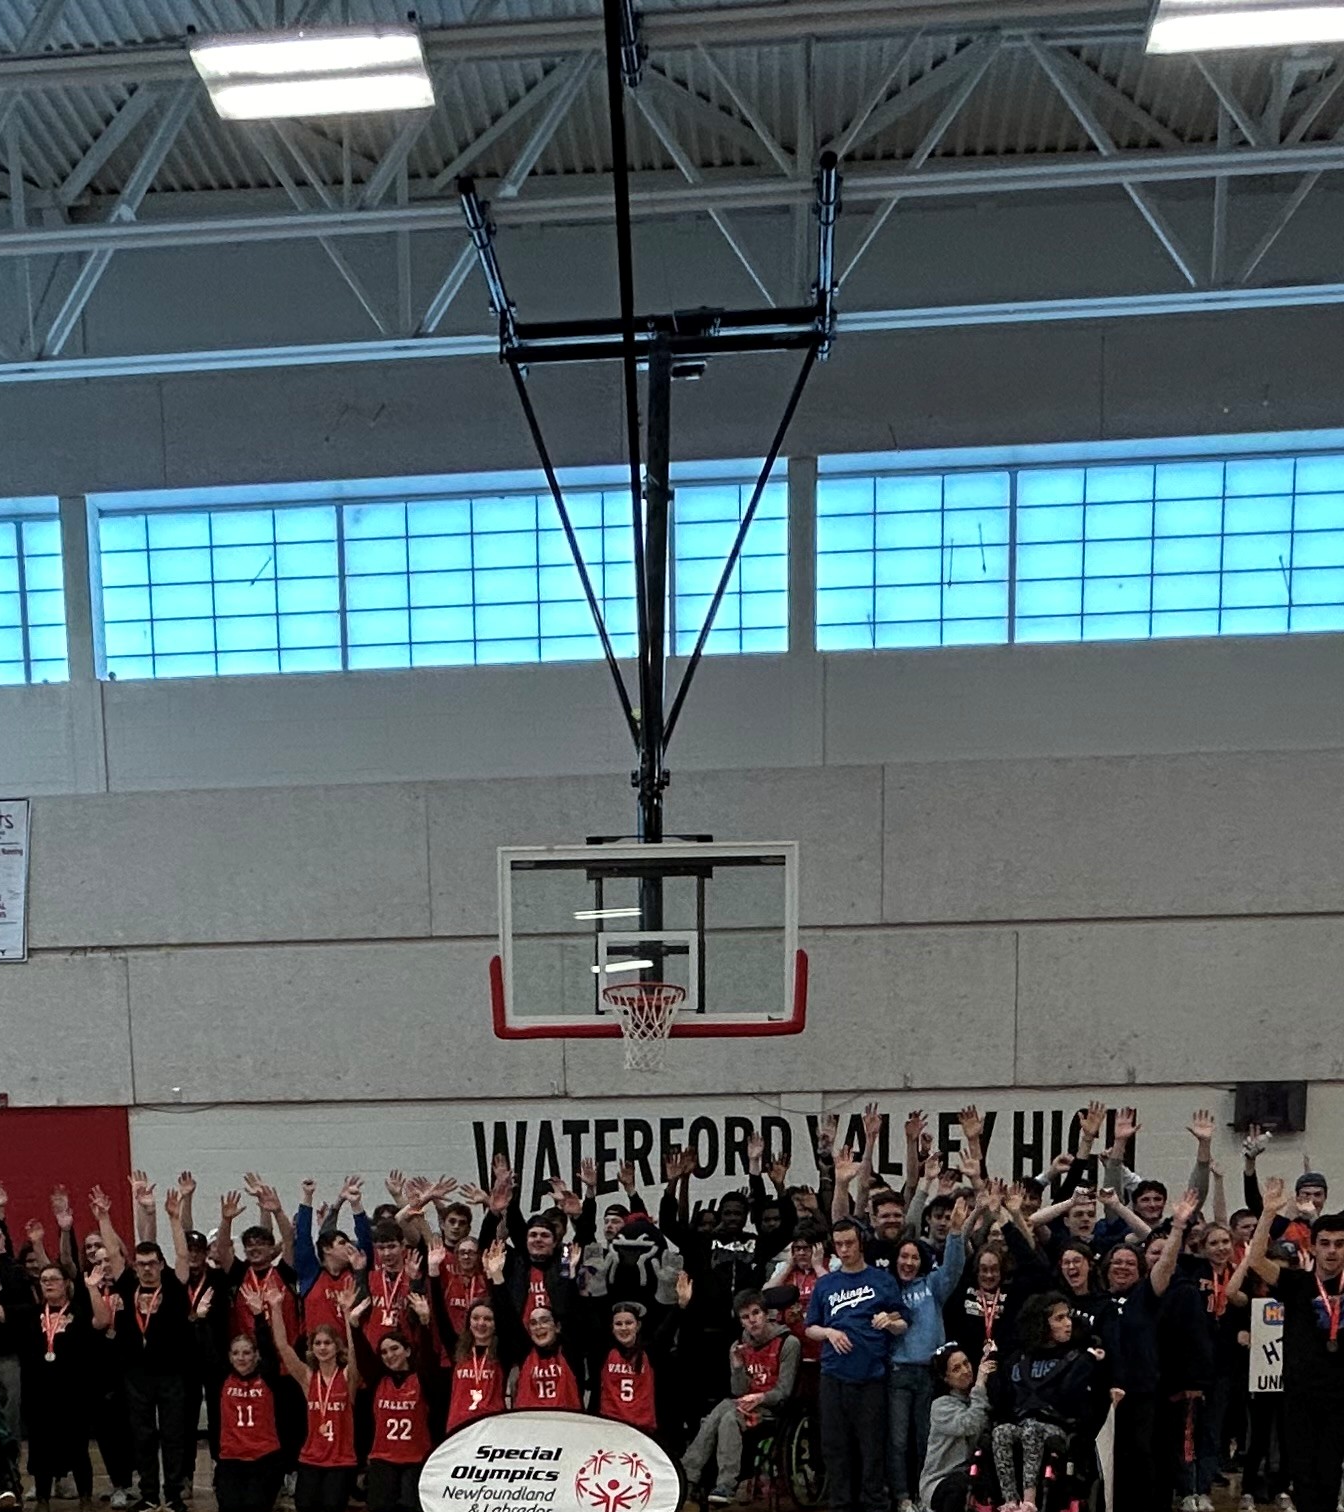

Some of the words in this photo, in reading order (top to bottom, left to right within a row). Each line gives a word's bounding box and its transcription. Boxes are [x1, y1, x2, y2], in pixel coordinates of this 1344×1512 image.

[472, 1115, 792, 1213] WATERFORD
[828, 1285, 873, 1307] Vikings
[537, 1380, 557, 1399] 12
[620, 1379, 634, 1402] 5
[308, 1401, 346, 1411] VALEY
[378, 1399, 417, 1411] VALLEY
[236, 1405, 255, 1427] 11
[322, 1420, 335, 1441] 4
[386, 1418, 413, 1441] 22
[476, 1445, 563, 1463] Special
[451, 1466, 560, 1483] Olympics
[442, 1485, 556, 1502] Newfoundland
